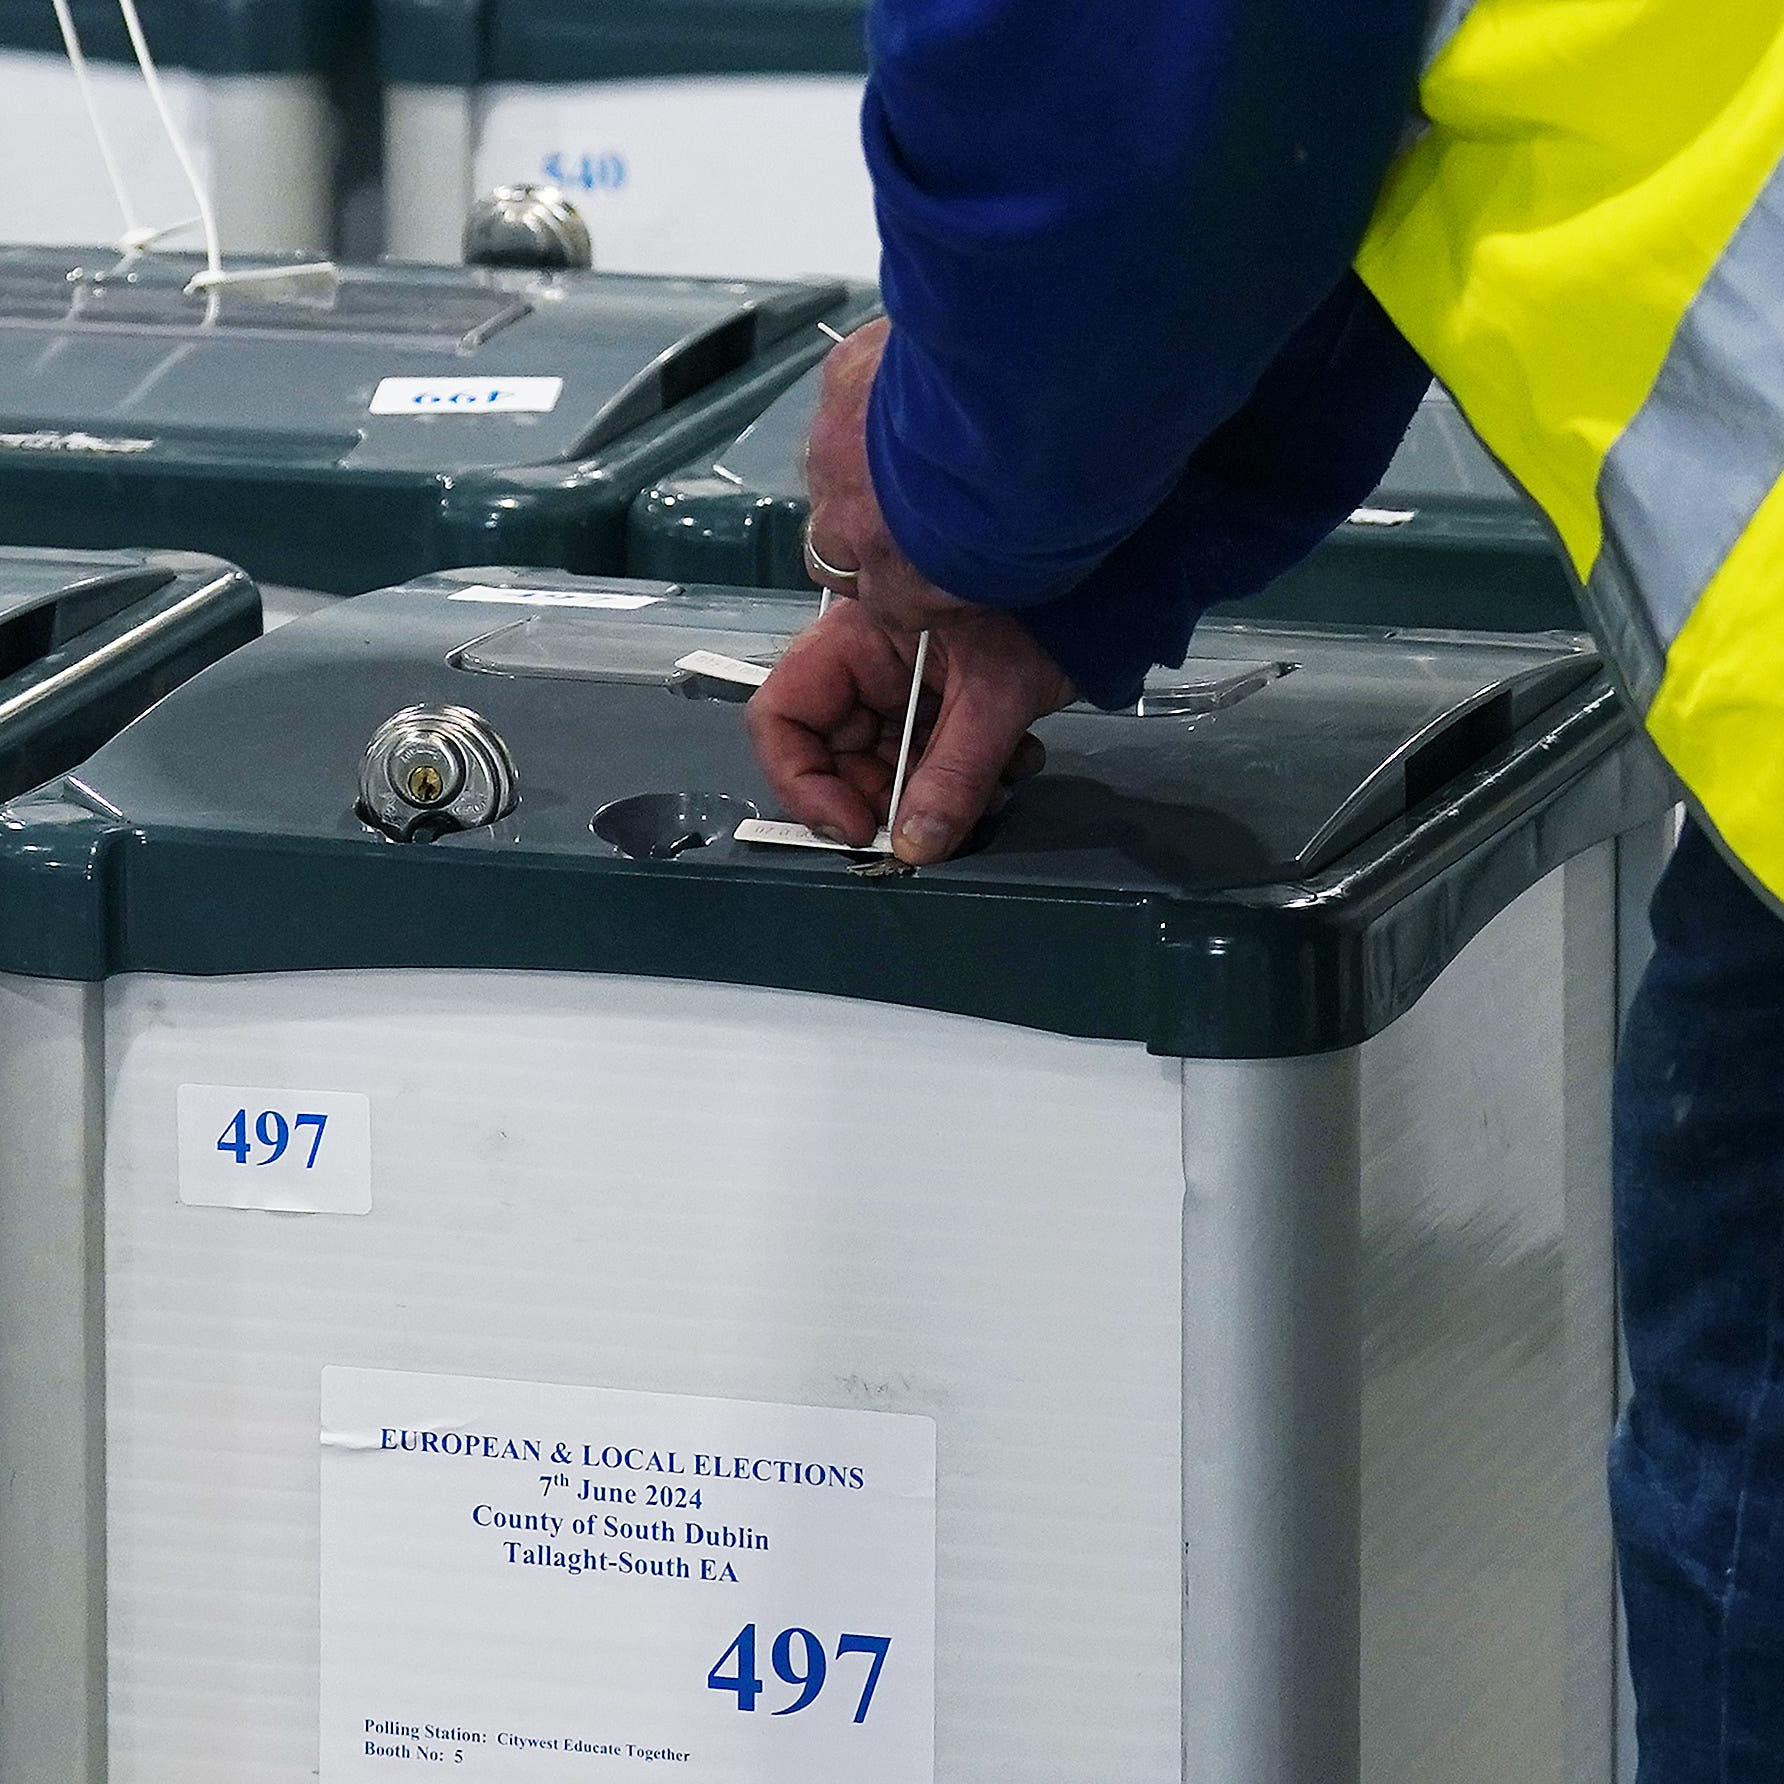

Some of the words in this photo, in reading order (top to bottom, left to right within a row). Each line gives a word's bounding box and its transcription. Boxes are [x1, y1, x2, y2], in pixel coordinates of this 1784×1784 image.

[217, 1109, 328, 1168] 497
[380, 1429, 541, 1461] EUROPEAN
[551, 1442, 572, 1464] &
[584, 1445, 684, 1473] LOCAL
[694, 1455, 863, 1489] ELECTIONS
[540, 1473, 568, 1496] 7th
[578, 1480, 636, 1504] June
[646, 1485, 702, 1509] 2024
[473, 1505, 563, 1538] County
[573, 1515, 597, 1535] of
[604, 1516, 674, 1542] South
[685, 1523, 768, 1550] Dublin
[503, 1541, 690, 1579] Tallaght-South
[701, 1559, 739, 1582] EA
[708, 1624, 892, 1723] 497
[365, 1741, 409, 1758] Booth
[418, 1746, 443, 1761] No:
[455, 1750, 462, 1763] 5
[366, 1720, 419, 1740] Polling
[425, 1724, 486, 1743] Station:
[498, 1733, 557, 1750] Citywest
[565, 1739, 620, 1755] Educate
[626, 1744, 690, 1761] Together
